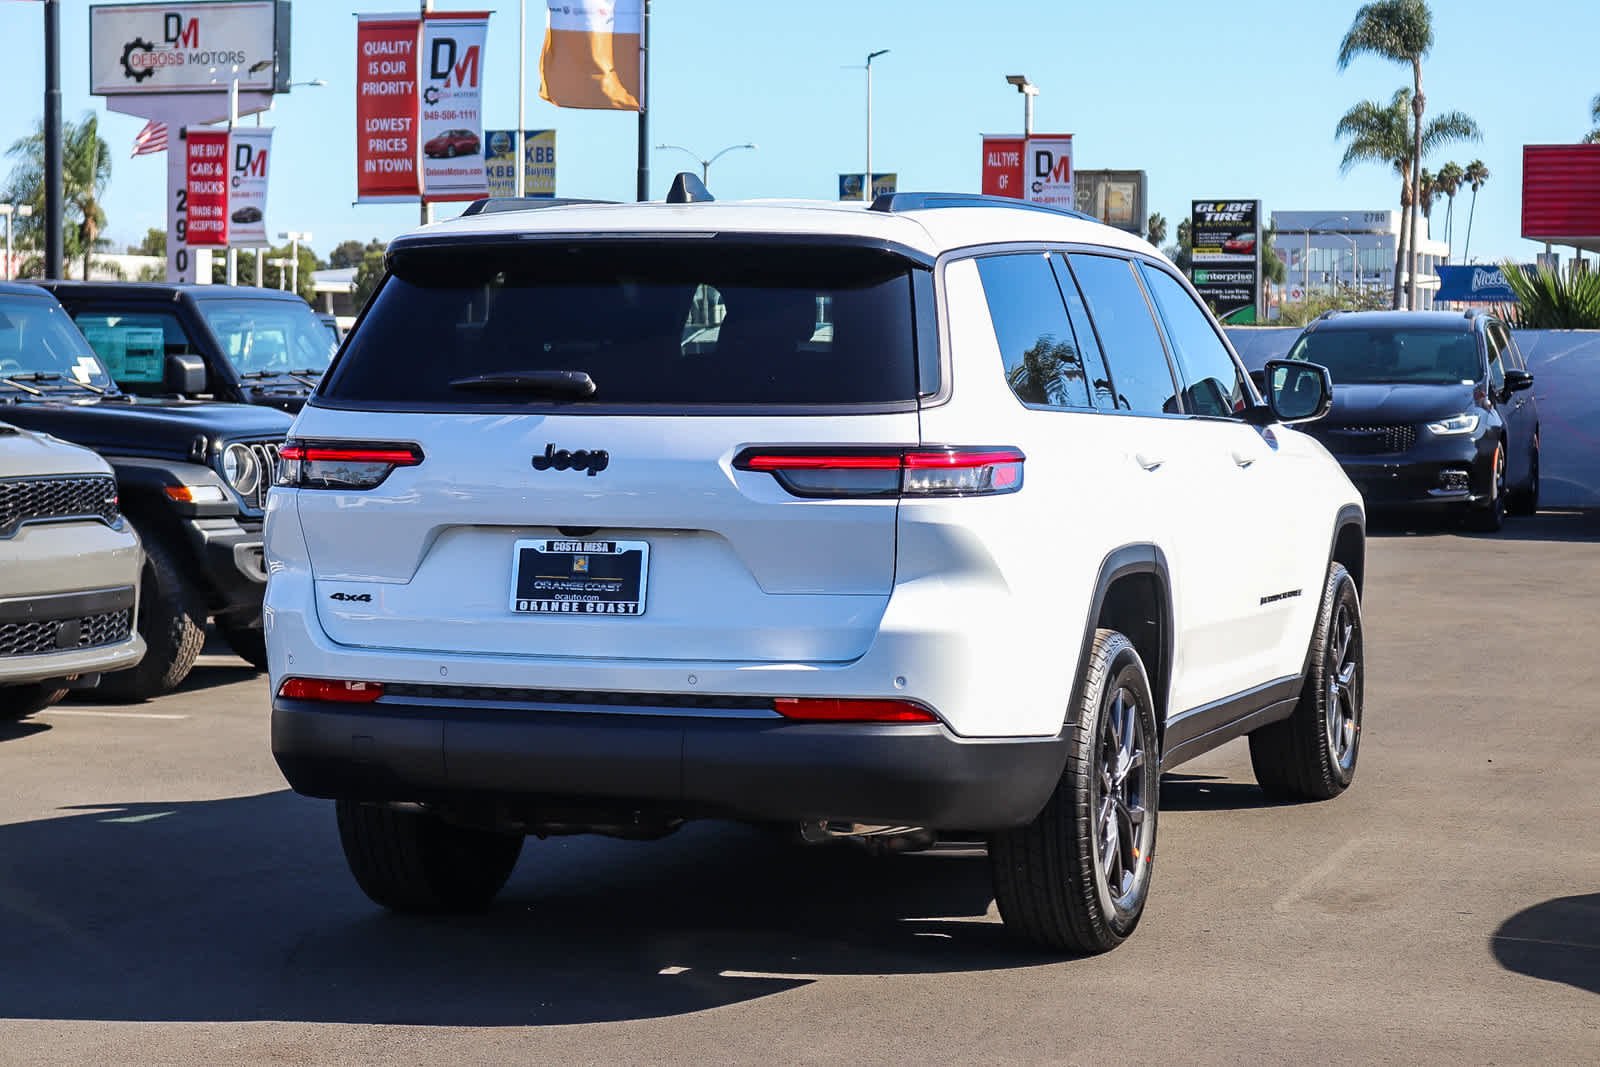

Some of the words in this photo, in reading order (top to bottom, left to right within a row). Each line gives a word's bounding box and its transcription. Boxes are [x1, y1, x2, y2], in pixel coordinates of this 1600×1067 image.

[364, 40, 413, 55] QUALITY
[189, 51, 245, 65] MOTORS
[369, 61, 379, 75] IS
[381, 61, 406, 75] OUR
[362, 81, 414, 96] PRIORITY
[365, 118, 412, 132] LOWEST
[189, 144, 204, 156] WE
[207, 144, 224, 156] BUY
[368, 138, 408, 152] PRICES
[525, 147, 554, 163] KBB
[988, 152, 1001, 167] ALL
[1002, 152, 1020, 167] TYPE
[190, 163, 213, 175] CARS
[215, 164, 223, 175] &
[364, 160, 376, 173] IN
[378, 159, 413, 172] TOWN
[486, 165, 514, 177] KBB
[189, 181, 225, 193] TRUCKS
[1000, 174, 1008, 189] OF
[190, 206, 222, 216] TRADE-IN
[1204, 212, 1244, 221] TIRE
[1198, 272, 1252, 281] enterprise
[532, 443, 608, 476] Jeep
[553, 542, 582, 552] COSTA
[584, 542, 608, 552] MESA
[534, 580, 583, 591] ORANGE
[585, 582, 622, 592] COAST
[554, 593, 600, 602] ocauto.com
[520, 600, 580, 612] ORANGE
[586, 603, 636, 613] COAST
